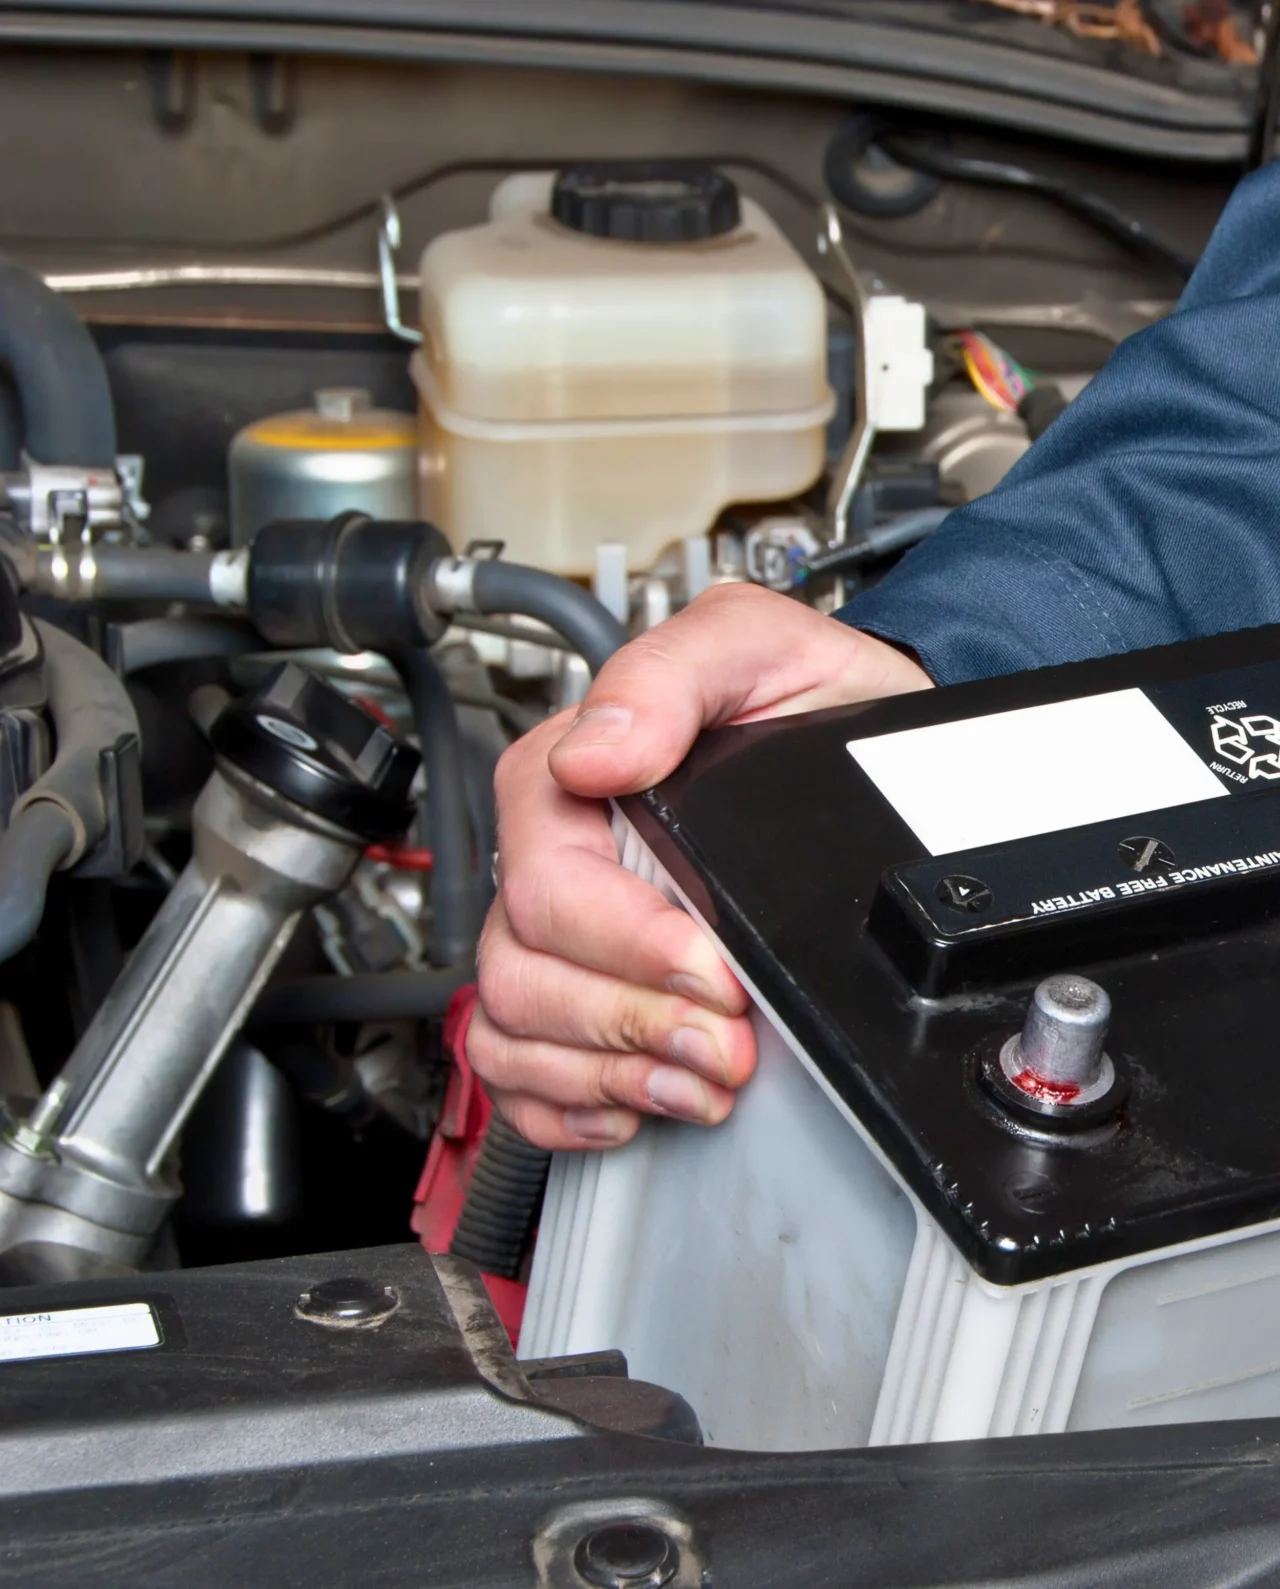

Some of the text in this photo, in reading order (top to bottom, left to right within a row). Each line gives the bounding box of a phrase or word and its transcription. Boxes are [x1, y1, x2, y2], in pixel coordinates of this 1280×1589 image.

[1205, 700, 1248, 715] RECYCLE
[1209, 761, 1249, 784] RETURN
[1120, 874, 1170, 896] FREE
[1031, 886, 1116, 915] BATTERY
[6, 1314, 52, 1325] TION
